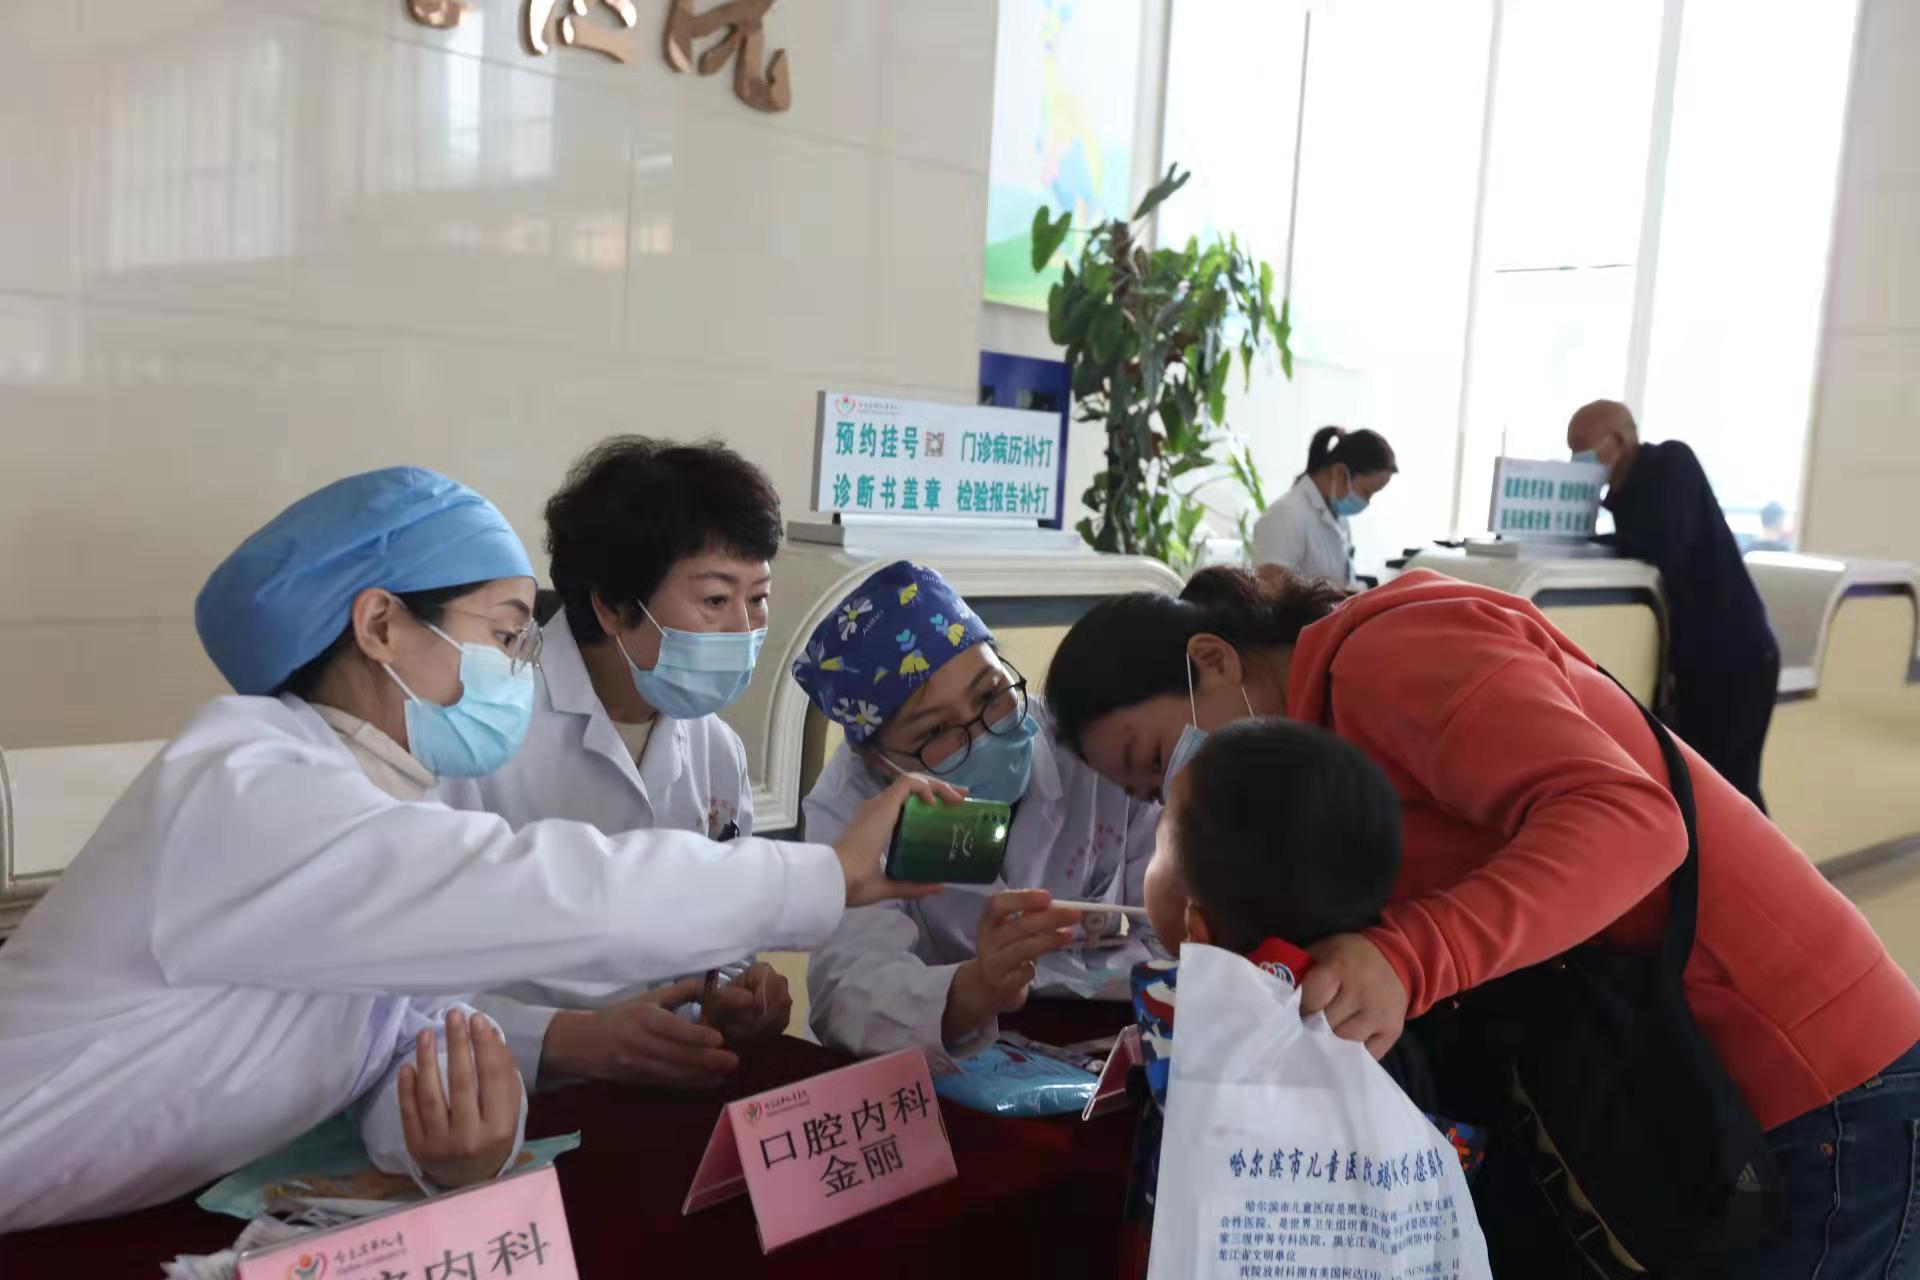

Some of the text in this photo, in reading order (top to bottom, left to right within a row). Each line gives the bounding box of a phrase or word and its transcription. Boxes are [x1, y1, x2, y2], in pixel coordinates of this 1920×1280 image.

[835, 421, 919, 459] 预约挂号
[960, 431, 1053, 468] 门诊病历补打
[833, 473, 941, 512] 诊断书盖章
[957, 479, 1049, 514] 检验报告补打
[760, 1081, 931, 1168] 口腔内科
[819, 1134, 904, 1198] 金丽
[362, 1222, 549, 1280] 内科
[1219, 1248, 1296, 1262] 龙江省文明单位
